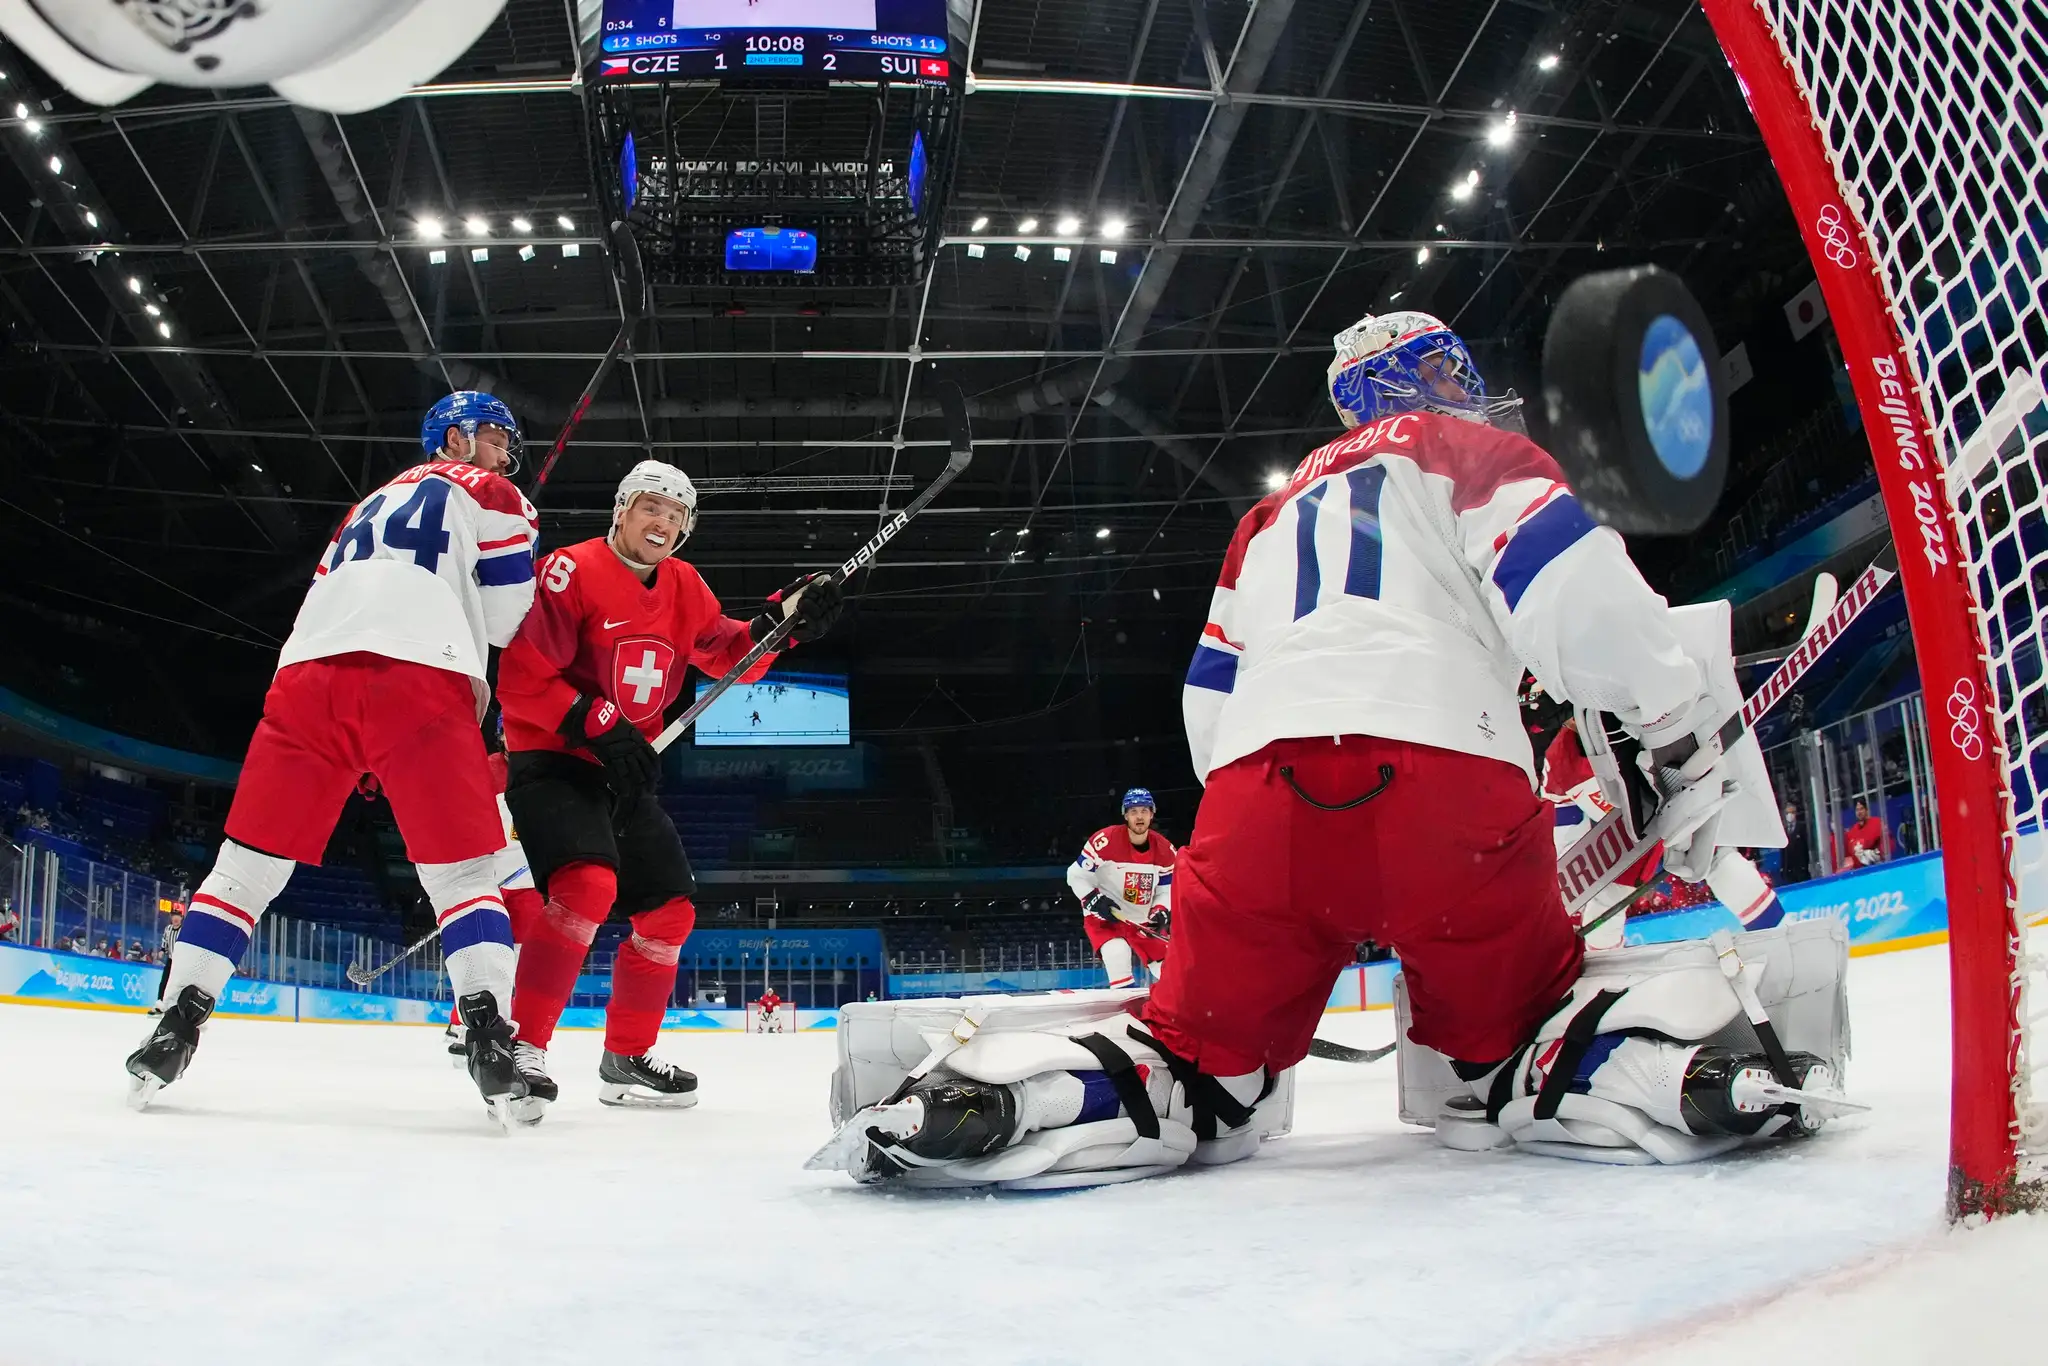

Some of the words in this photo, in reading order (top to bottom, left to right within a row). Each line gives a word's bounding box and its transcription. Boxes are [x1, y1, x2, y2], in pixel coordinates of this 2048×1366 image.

[606, 20, 633, 31] 0:34
[658, 17, 666, 27] 5
[612, 38, 630, 49] 12
[635, 34, 678, 46] SHOTS
[745, 36, 805, 51] 10:08
[870, 35, 913, 47] SHOTS
[920, 39, 937, 50] 11
[632, 55, 680, 74] CZE
[714, 53, 728, 70] 1
[749, 56, 767, 64] 2ND
[768, 56, 800, 64] PERIOD
[822, 54, 837, 71] 2
[881, 56, 918, 75] SUI
[1872, 354, 1924, 470] BEIJING
[1908, 480, 1948, 577] 2022
[329, 476, 452, 575] 84
[1293, 463, 1387, 623] 11
[1742, 568, 1880, 728] WARRIOR
[1092, 832, 1109, 851] 13
[1854, 890, 1909, 922] 2022
[738, 938, 778, 950] BEIJING
[781, 939, 810, 949] 2022
[56, 969, 89, 991] BEIJING
[90, 974, 115, 991] 2022
